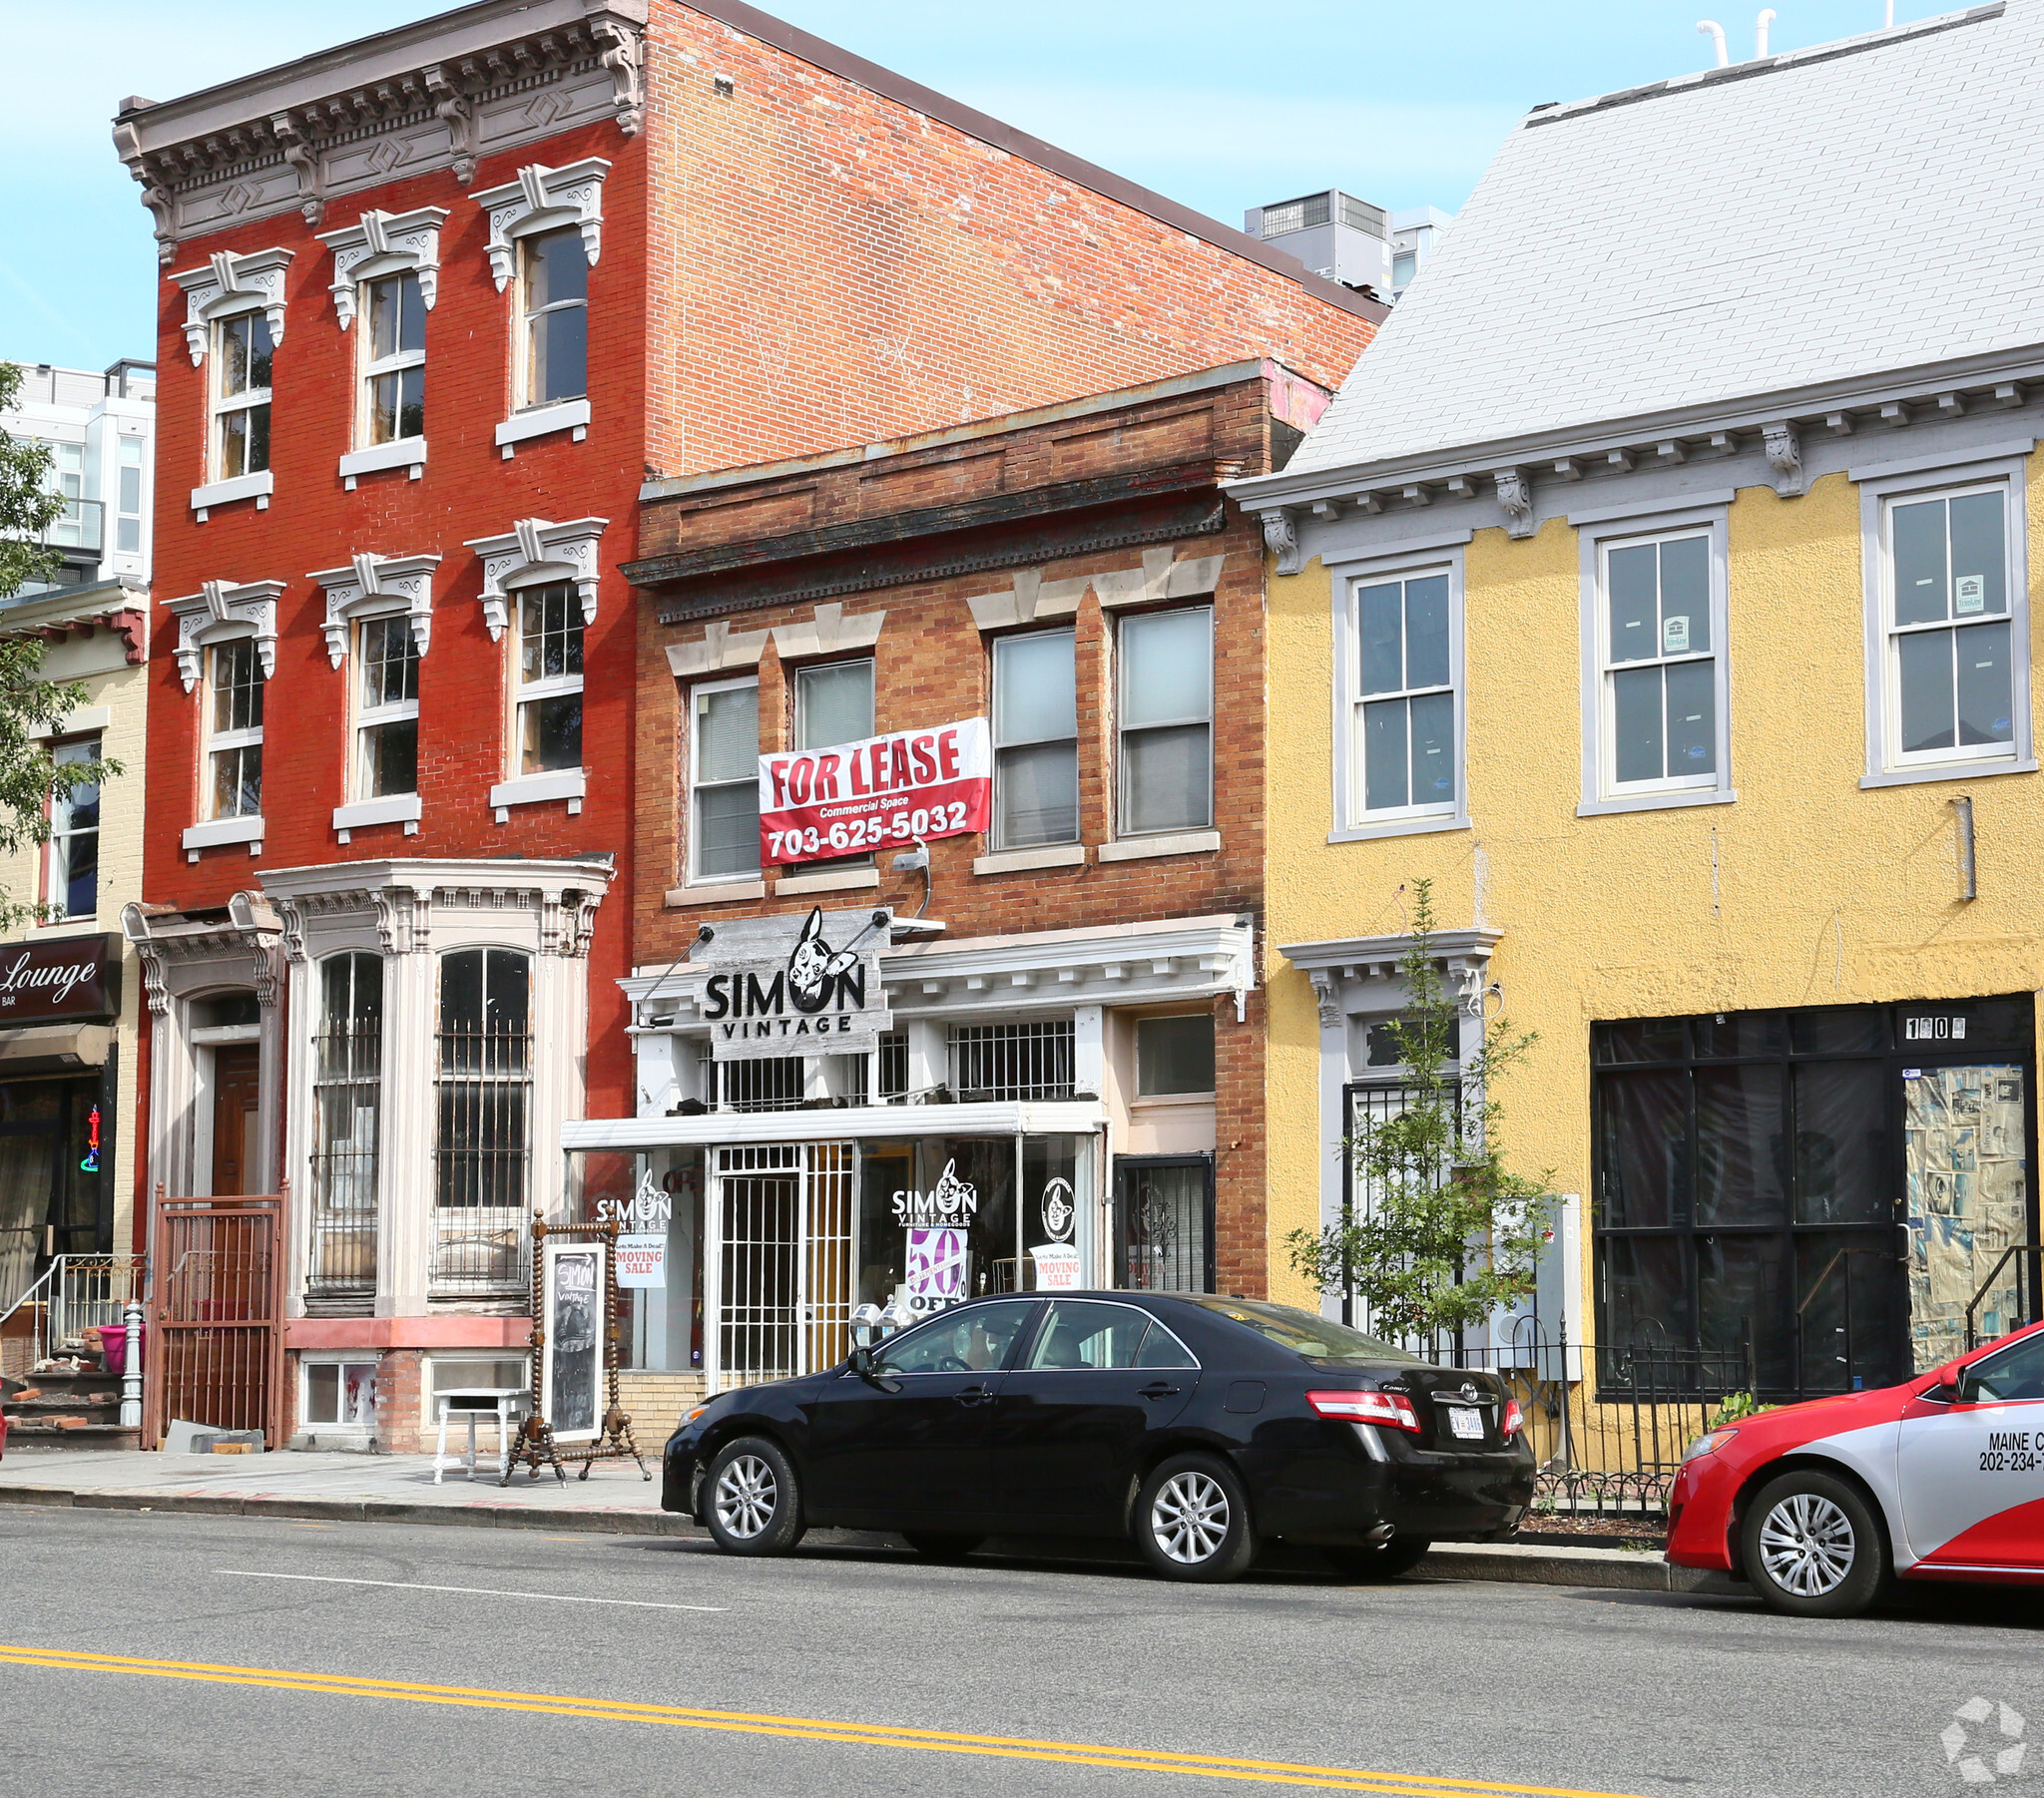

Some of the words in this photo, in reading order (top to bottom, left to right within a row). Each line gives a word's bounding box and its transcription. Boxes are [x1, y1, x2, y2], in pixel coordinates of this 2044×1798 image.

[770, 754, 840, 808] FOR
[849, 729, 960, 796] LEASE
[819, 801, 878, 818] Commercial
[880, 796, 909, 811] Space
[768, 801, 967, 857] 703-625-5032
[0, 952, 96, 1004] Lounge
[705, 945, 865, 1020] SIMON
[2, 996, 16, 1007] BAR
[724, 1016, 851, 1039] VINTAGE
[663, 1168, 705, 1193] OPE
[597, 1198, 671, 1221] SIMON
[891, 1190, 977, 1214] SIMON
[619, 1220, 667, 1229] NTAGE
[898, 1213, 971, 1223] VINTAGE
[616, 1251, 662, 1262] MOVING
[558, 1263, 595, 1286] SIMON
[626, 1262, 653, 1274] SALE
[1039, 1261, 1079, 1274] MOVING
[1047, 1274, 1071, 1286] SALE
[558, 1291, 590, 1304] VINTAGE
[910, 1296, 960, 1312] OFF
[1989, 1433, 2029, 1451] MAINE
[1979, 1452, 2044, 1471] 202-234-
